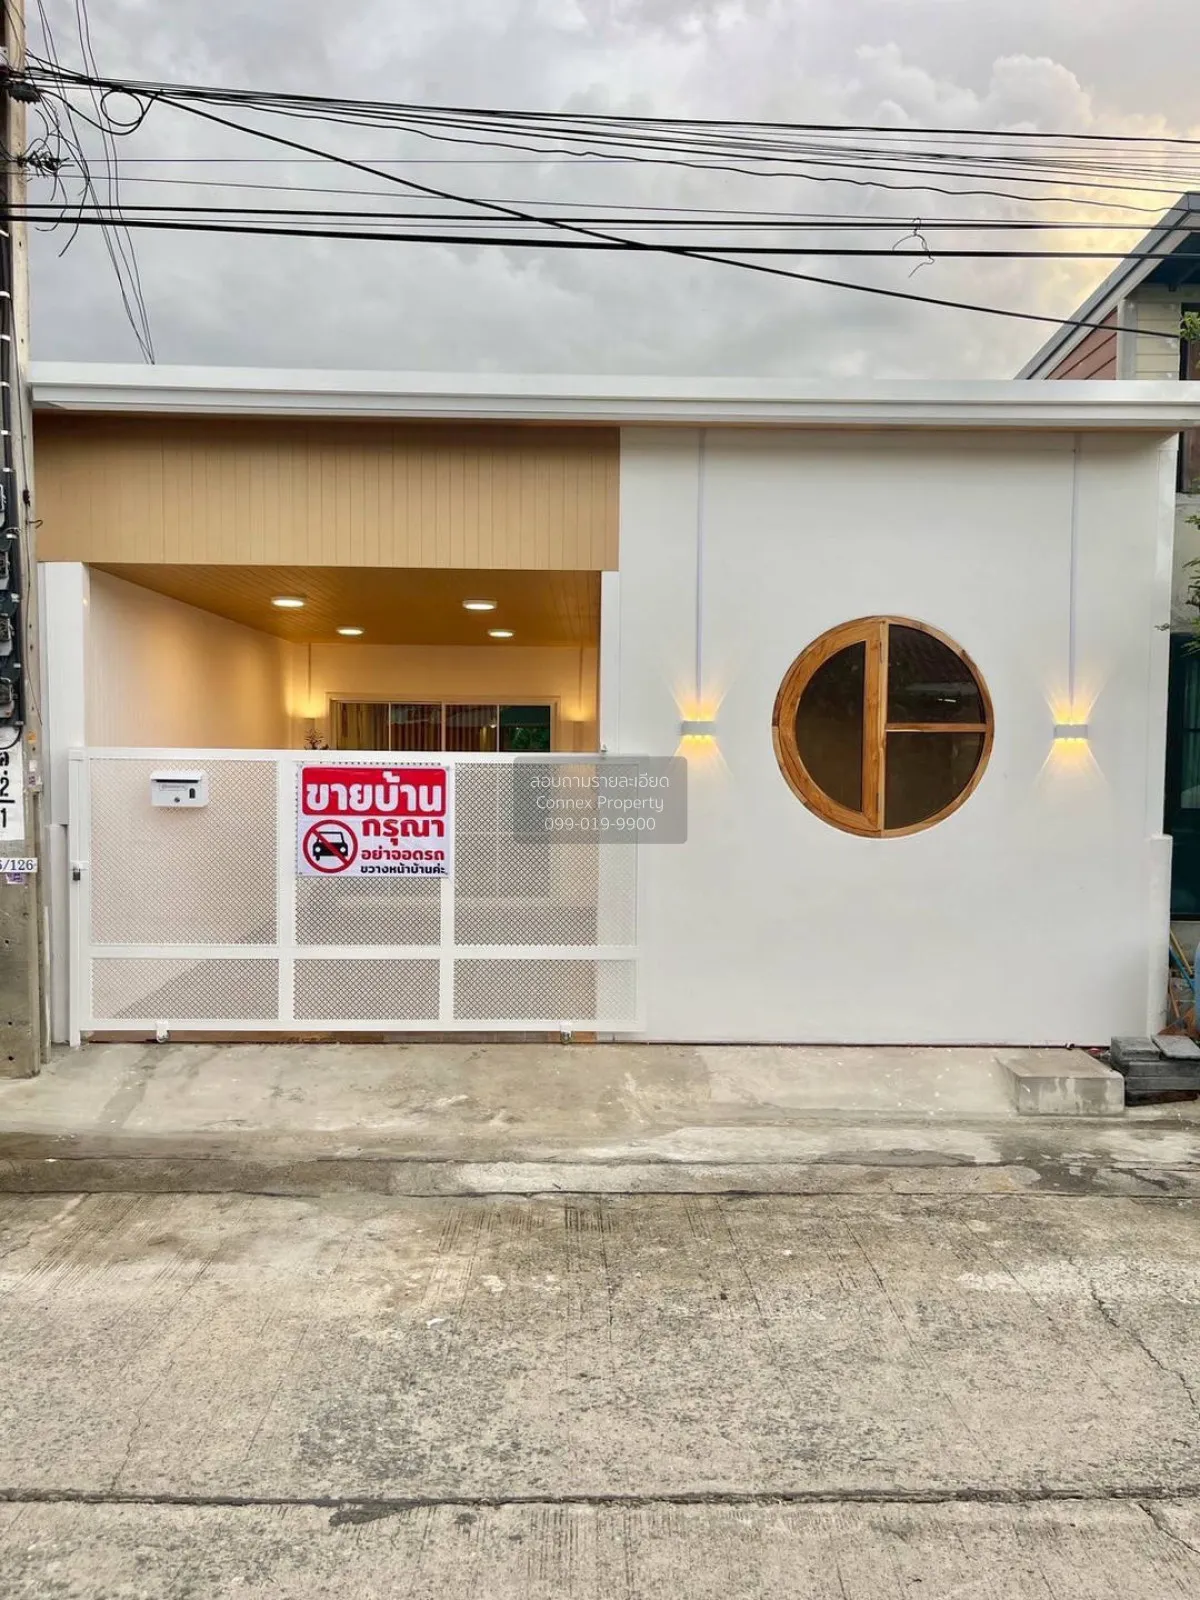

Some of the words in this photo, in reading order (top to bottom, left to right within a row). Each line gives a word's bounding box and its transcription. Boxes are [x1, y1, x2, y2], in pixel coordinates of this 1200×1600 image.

[306, 770, 442, 812] ขายบ้าน
[362, 819, 444, 846] กรุณา
[361, 845, 445, 861] อย่าจอดรถ
[360, 862, 446, 875] ขวางหน้าบ้านค่ะ
